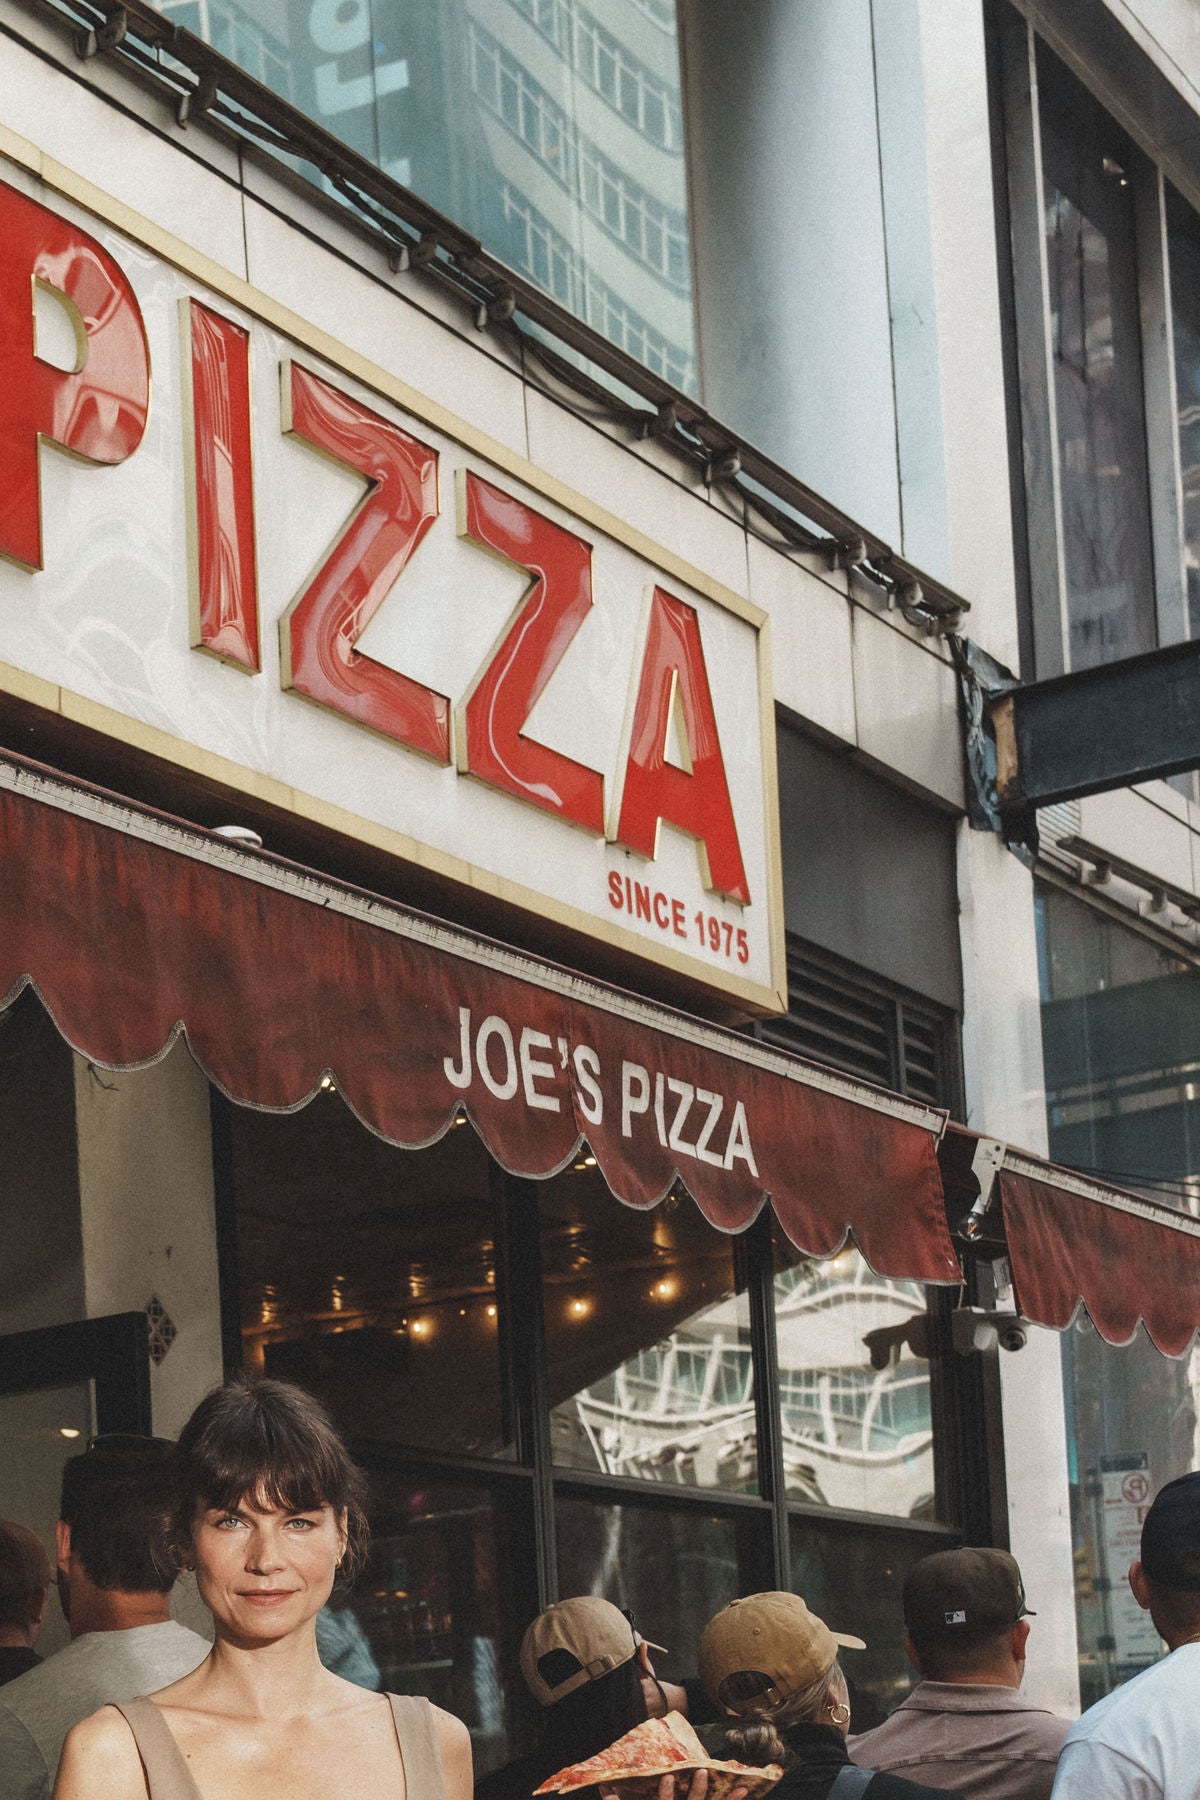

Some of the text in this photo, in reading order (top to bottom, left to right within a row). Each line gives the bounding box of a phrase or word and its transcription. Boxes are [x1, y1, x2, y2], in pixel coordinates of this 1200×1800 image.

[608, 870, 749, 964] SINCE 1975
[443, 1006, 759, 1178] JOE'S PIZZA
